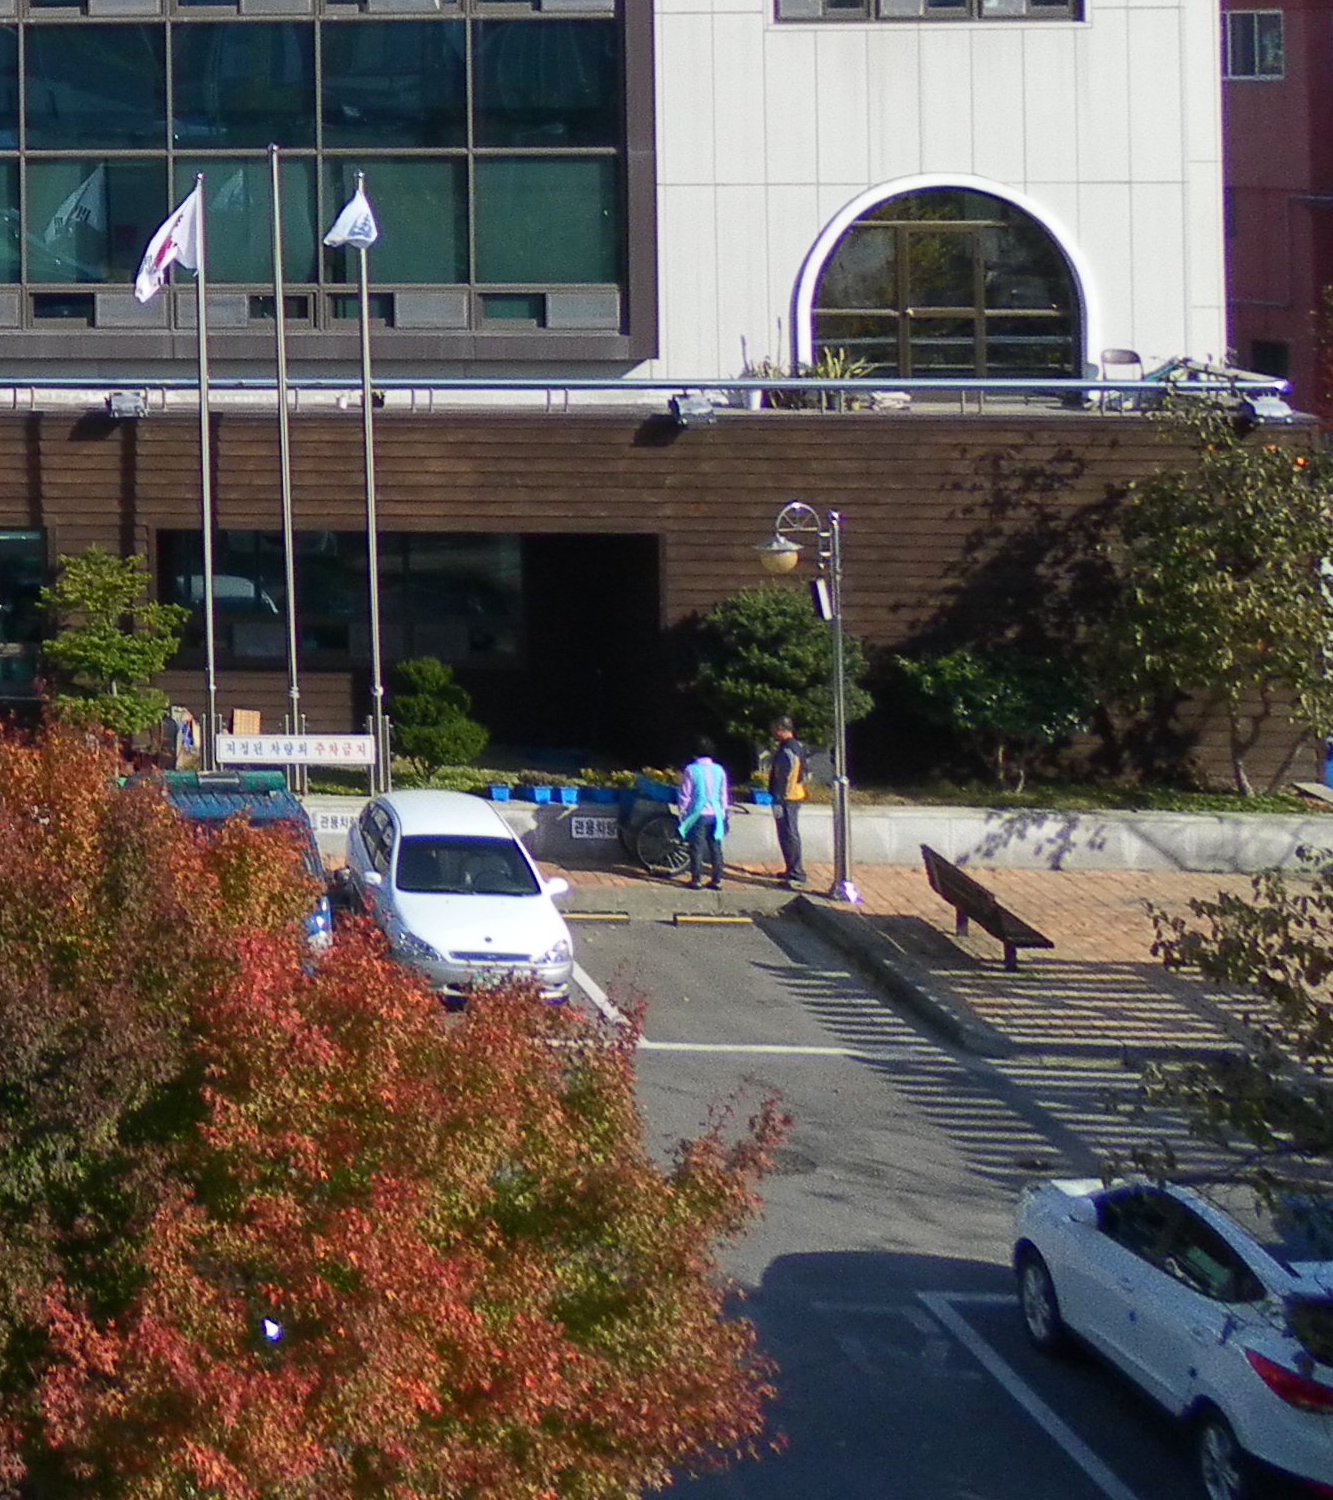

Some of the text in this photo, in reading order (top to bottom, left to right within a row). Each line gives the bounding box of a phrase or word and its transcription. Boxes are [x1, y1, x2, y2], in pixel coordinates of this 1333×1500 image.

[226, 740, 367, 757] 지정된 차량외 주차금지
